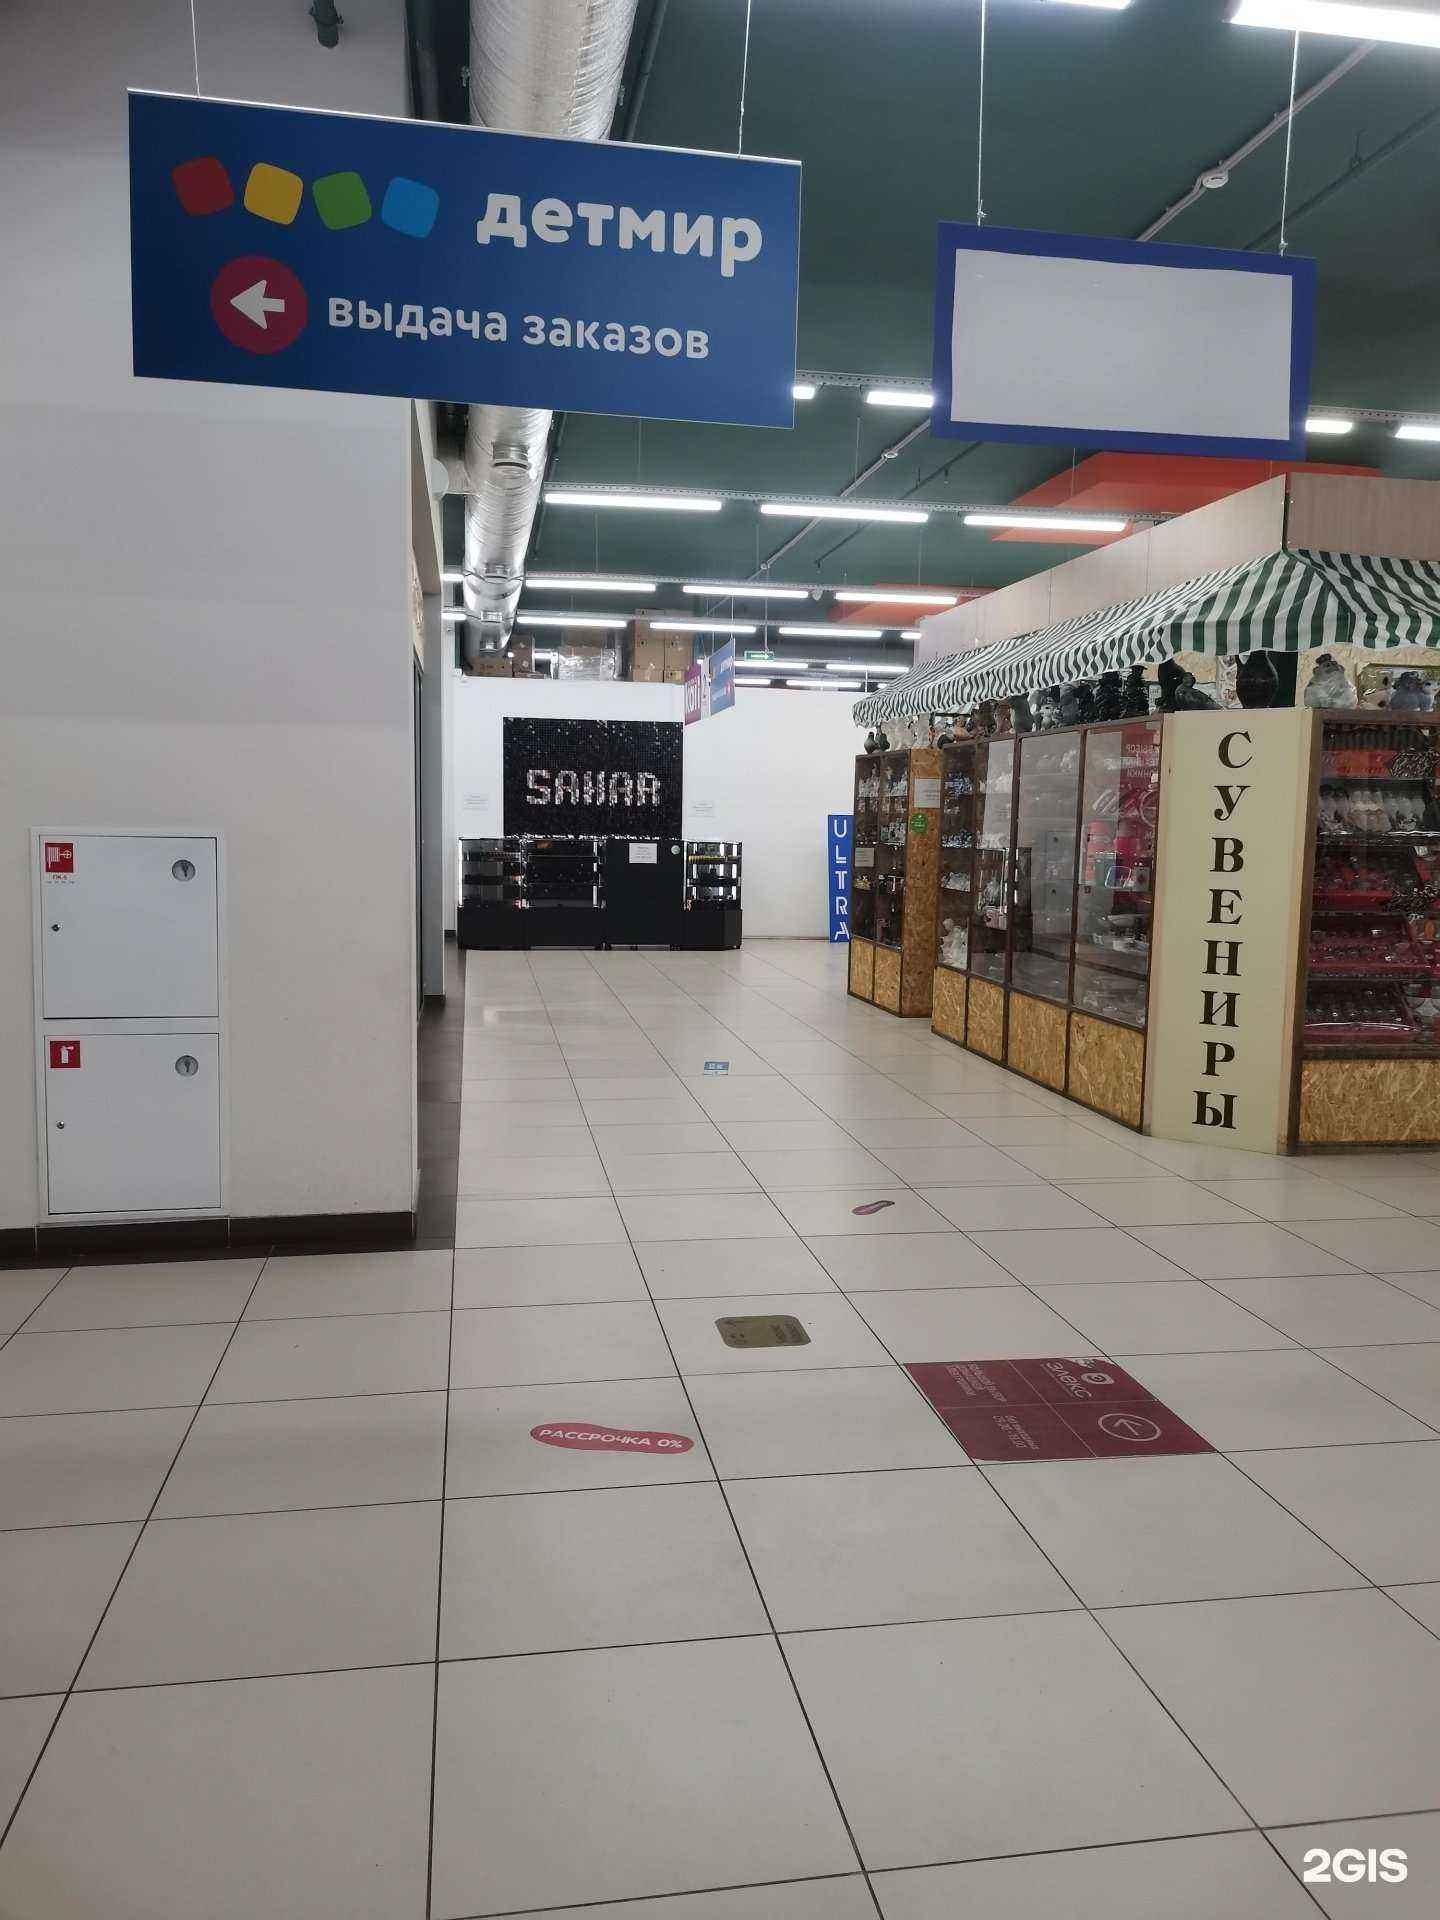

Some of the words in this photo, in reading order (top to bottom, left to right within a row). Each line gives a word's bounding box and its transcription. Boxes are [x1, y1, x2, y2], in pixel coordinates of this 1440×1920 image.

[477, 193, 762, 277] детмир
[328, 297, 507, 342] выдача
[522, 314, 710, 359] заказов
[834, 819, 850, 941] ULTRA
[1191, 731, 1253, 1130] СУВЕНИРЫ
[539, 1429, 651, 1446] РАССРОЧКА
[657, 1438, 683, 1449] 0%
